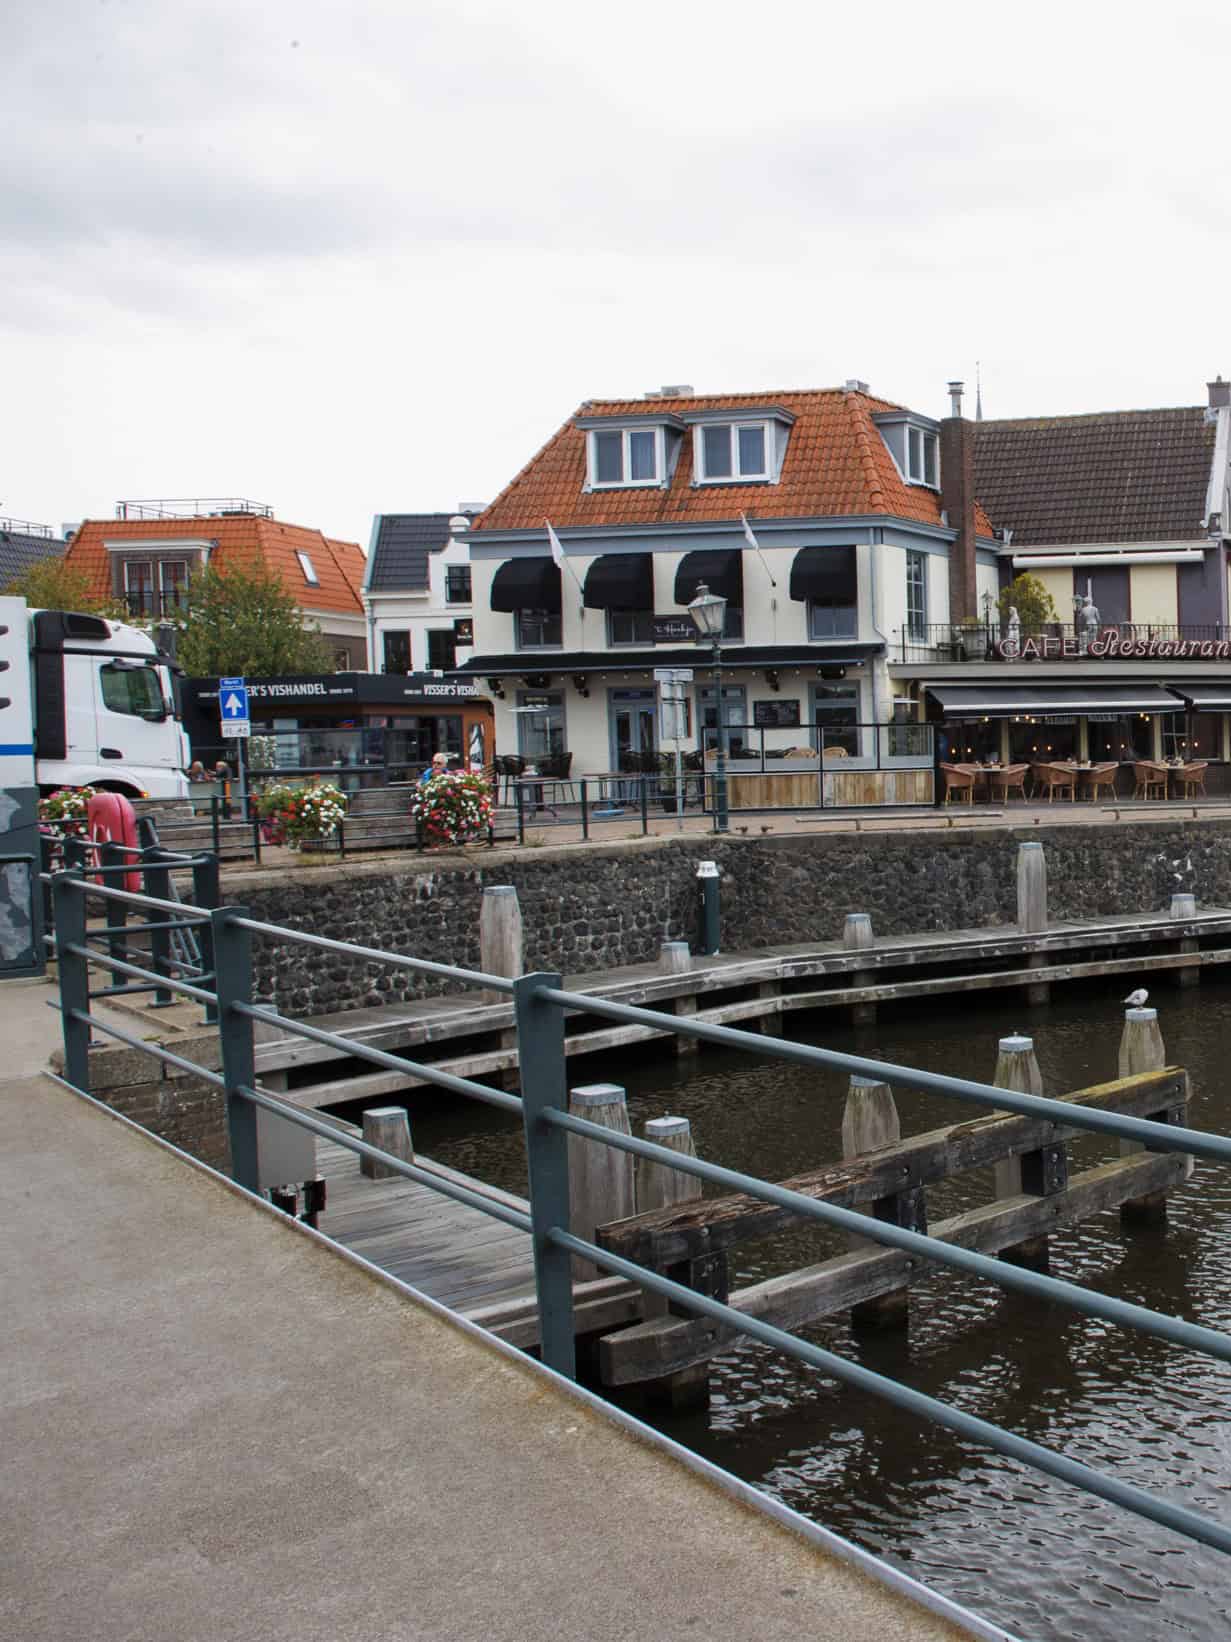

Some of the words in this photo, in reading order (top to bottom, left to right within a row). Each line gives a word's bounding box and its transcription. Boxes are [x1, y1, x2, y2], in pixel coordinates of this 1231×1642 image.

[999, 637, 1080, 658] CAFE
[268, 682, 327, 697] VISHANDEL
[423, 684, 456, 696] VISSER'S
[457, 685, 480, 696] VISHA
